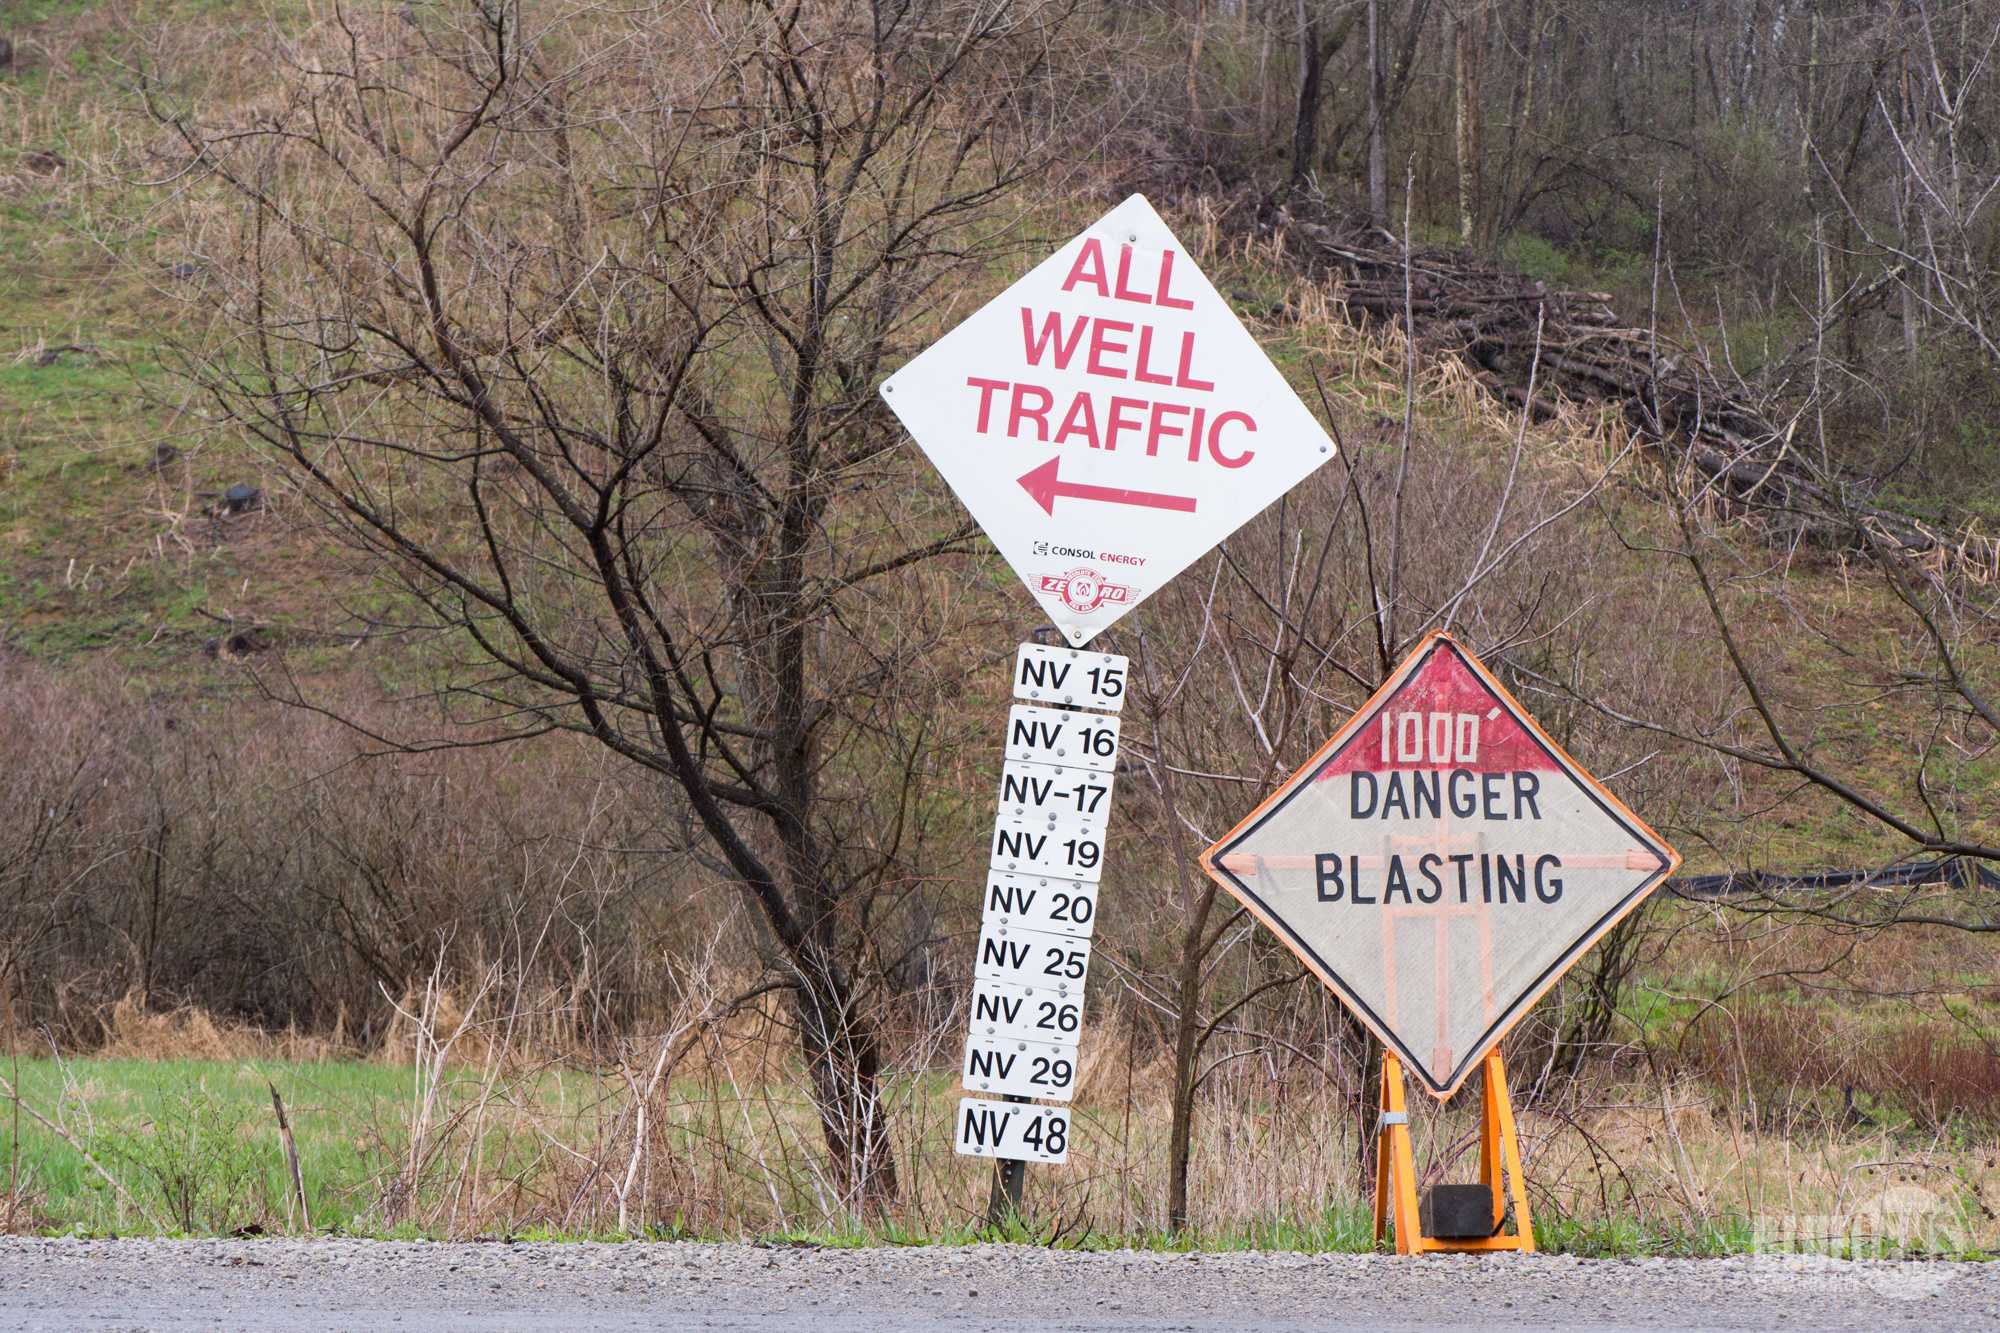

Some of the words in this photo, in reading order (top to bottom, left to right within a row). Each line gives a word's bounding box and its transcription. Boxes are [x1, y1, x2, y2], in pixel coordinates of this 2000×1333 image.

[1061, 237, 1195, 311] ALL
[1020, 306, 1215, 393] WELL
[966, 376, 1258, 470] TRAFFIC
[1051, 546, 1096, 560] CONSOL
[1099, 552, 1147, 567] ENERGY
[1020, 657, 1072, 690] NV
[1086, 667, 1124, 698] 15
[1012, 718, 1063, 750] NV
[1078, 727, 1115, 757] 16
[1350, 768, 1543, 821] DANGER
[997, 829, 1048, 861] NV
[1063, 839, 1100, 869] 19
[1314, 852, 1564, 905] BLASTING
[989, 884, 1037, 916] NV
[1049, 893, 1093, 924] 20
[982, 938, 1031, 970] NV
[1043, 947, 1086, 979] 25
[976, 993, 1024, 1024] NV
[1036, 1001, 1079, 1033] 26
[969, 1049, 1017, 1080] NV
[1029, 1057, 1073, 1088] 29
[963, 1108, 1011, 1148] NV
[1022, 1115, 1067, 1155] 48
